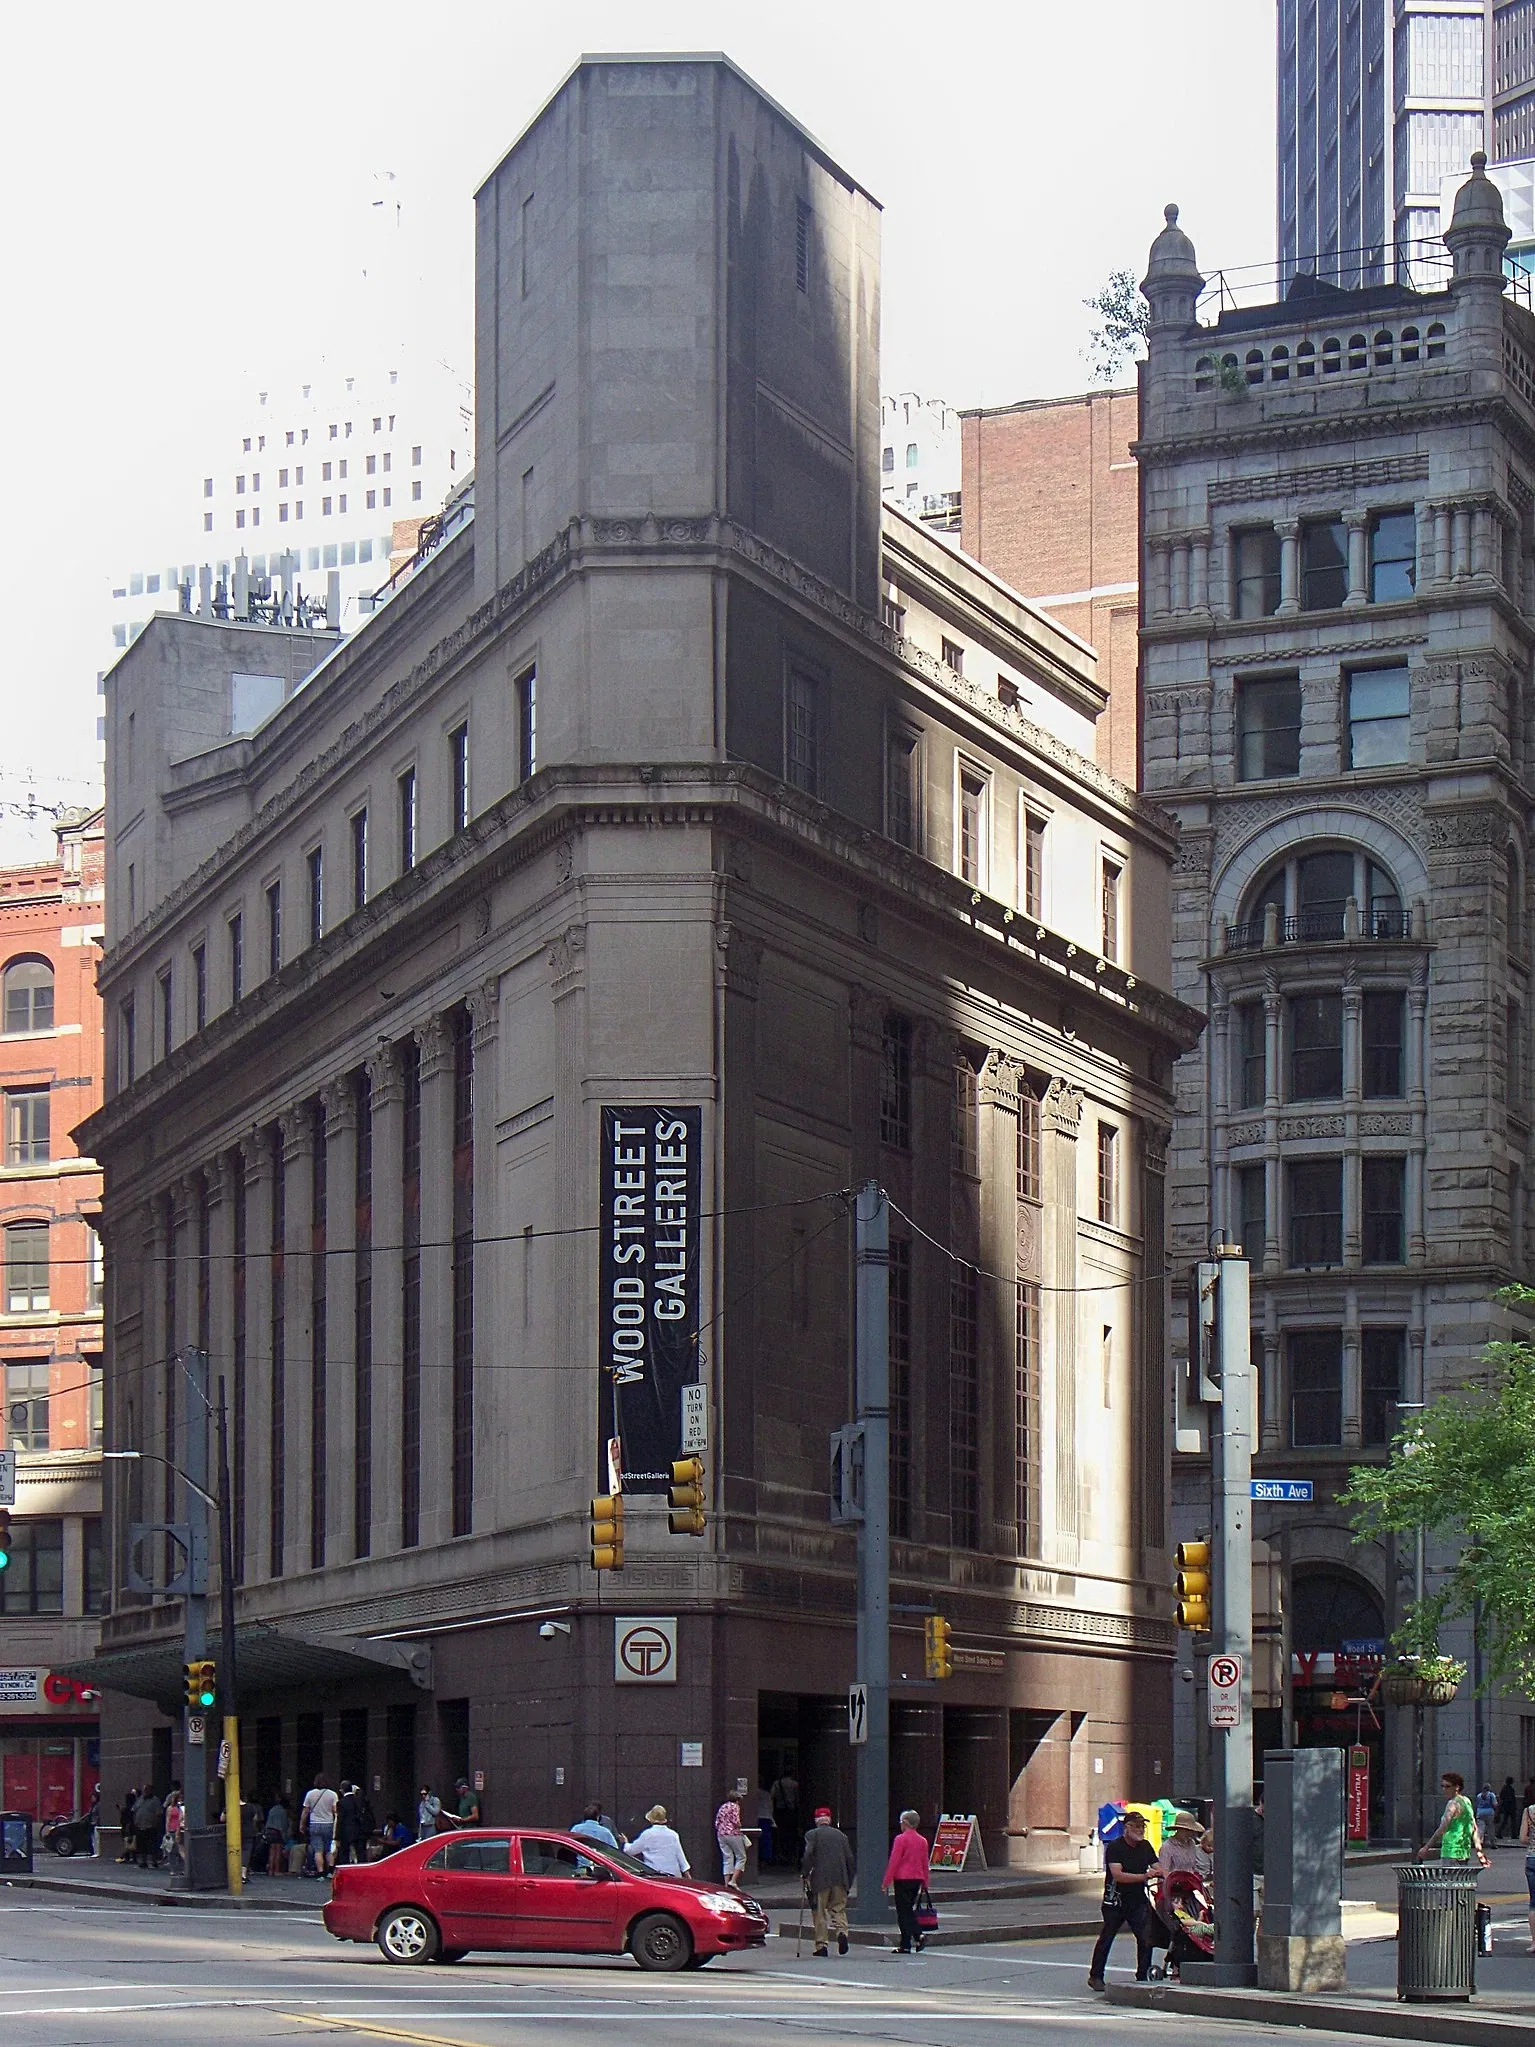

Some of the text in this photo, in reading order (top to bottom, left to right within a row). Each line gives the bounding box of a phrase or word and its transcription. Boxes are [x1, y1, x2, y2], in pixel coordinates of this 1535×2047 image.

[653, 1120, 687, 1320] GALLERIES
[612, 1120, 646, 1384] WOOD STREET
[688, 1389, 701, 1401] NO
[686, 1403, 703, 1413] TURN
[690, 1415, 700, 1425] ON
[689, 1427, 702, 1436] RED
[1255, 1483, 1309, 1498] Sixth Ave
[1346, 1644, 1377, 1653] Wood St
[1220, 1693, 1229, 1701] OR
[1212, 1705, 1238, 1713] STOPPING
